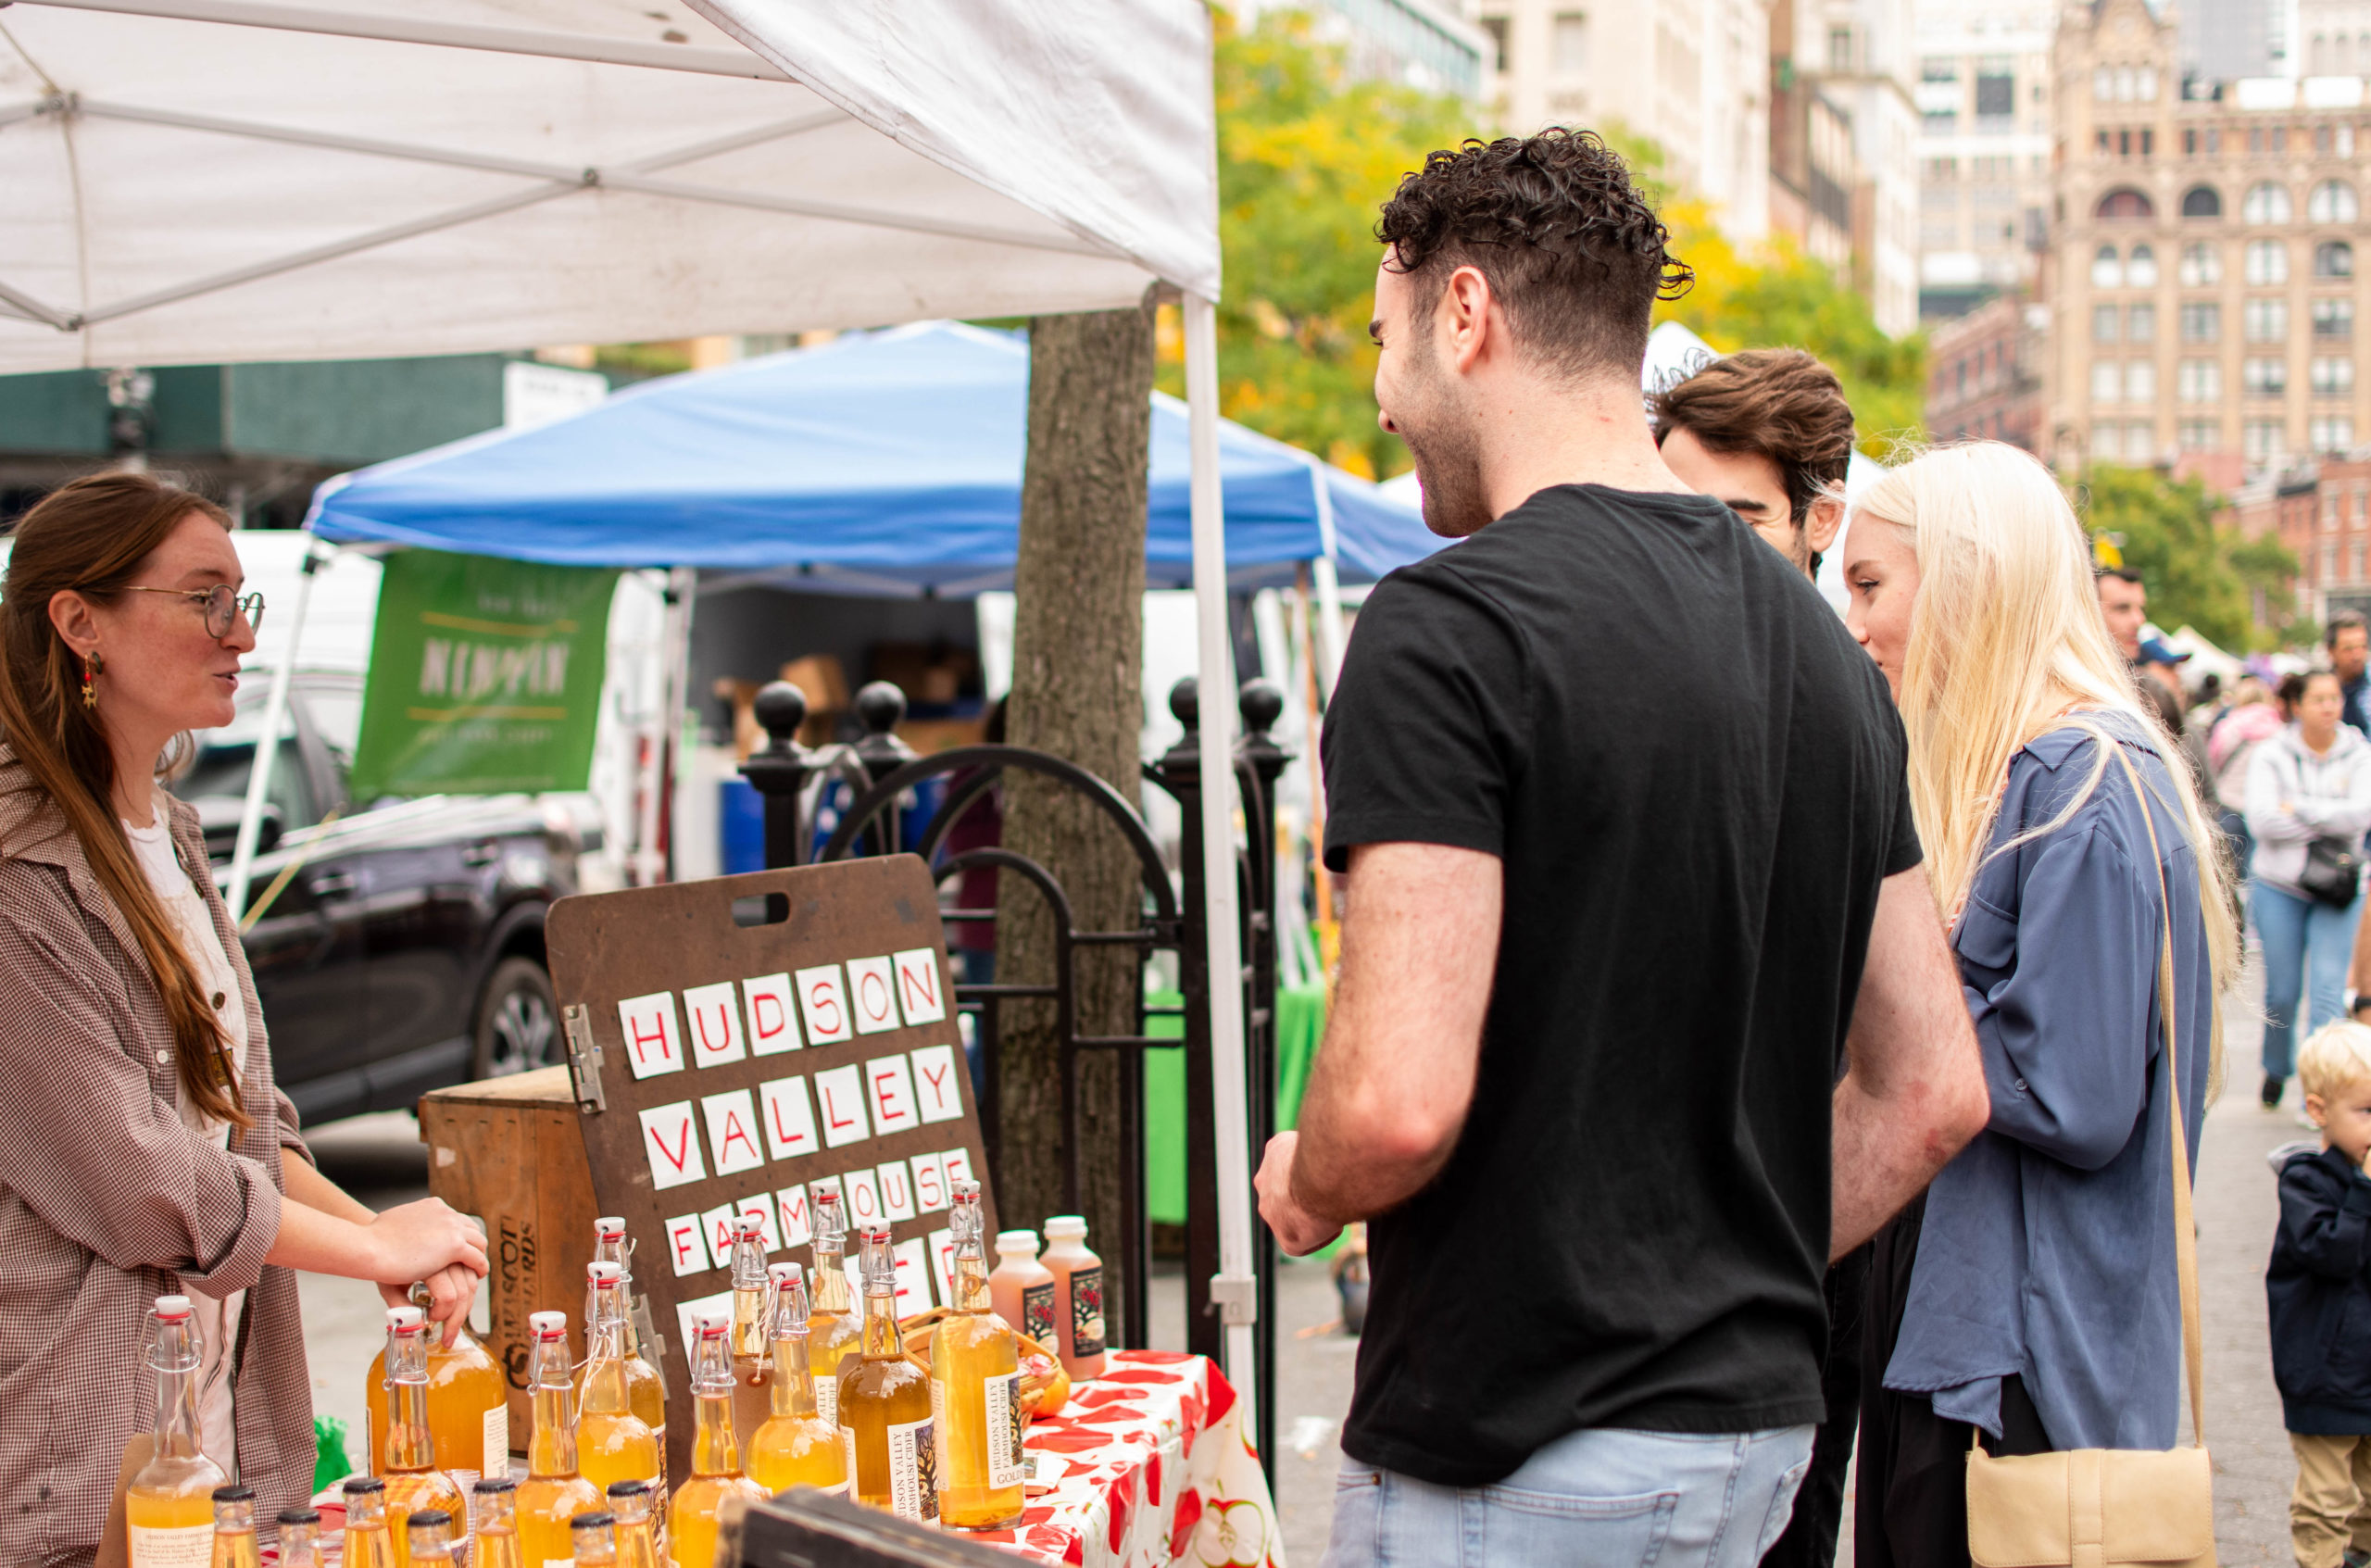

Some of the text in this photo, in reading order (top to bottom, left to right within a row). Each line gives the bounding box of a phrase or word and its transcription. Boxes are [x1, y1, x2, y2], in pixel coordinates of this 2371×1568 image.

[630, 961, 936, 1063] HUDSON
[650, 1062, 947, 1173] VALLEY
[818, 1382, 826, 1415] ALLEY
[989, 1384, 1001, 1471] HUDSON VALLEY
[999, 1412, 1010, 1470] FARMHOUSE
[894, 1433, 908, 1519] UDSON VALLEY
[905, 1430, 918, 1519] ARMHOUSE CIDER
